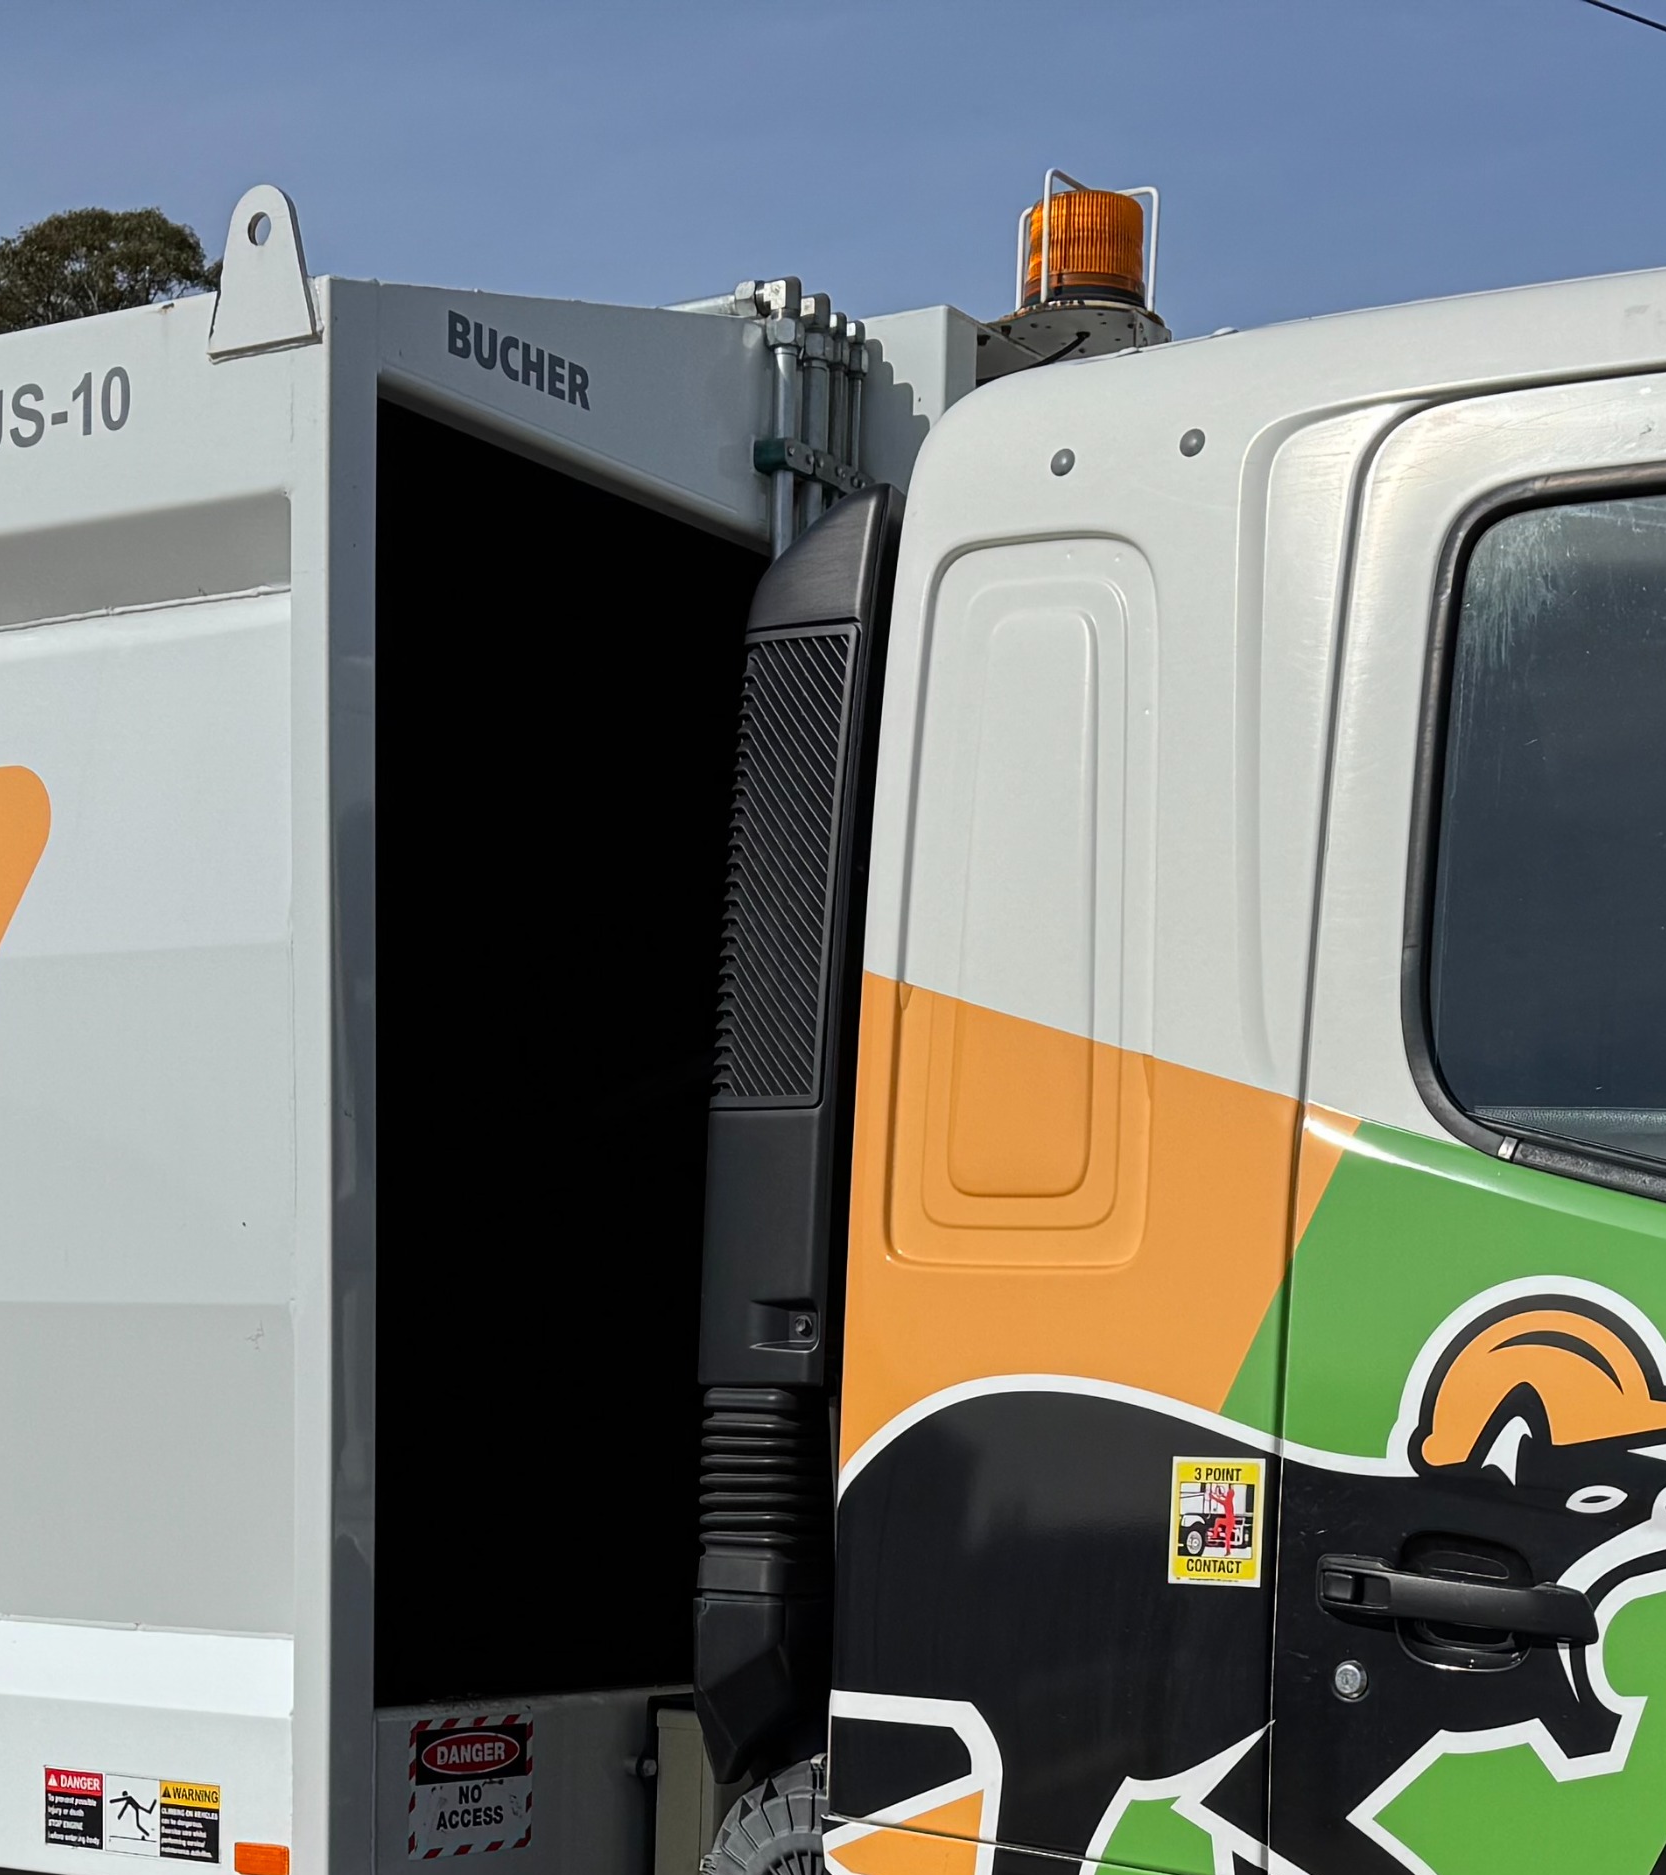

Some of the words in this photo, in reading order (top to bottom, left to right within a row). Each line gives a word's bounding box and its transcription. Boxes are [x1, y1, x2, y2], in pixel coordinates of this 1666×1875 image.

[447, 310, 591, 411] BUCHER
[1195, 1467, 1202, 1481] 3
[1205, 1468, 1242, 1481] POINT
[1186, 1559, 1242, 1574] CONTACT
[436, 1742, 505, 1765] DANGER
[60, 1775, 101, 1791] DANGER
[172, 1786, 219, 1804] WARNING
[459, 1785, 482, 1805] NO
[436, 1805, 504, 1830] ACCESS
